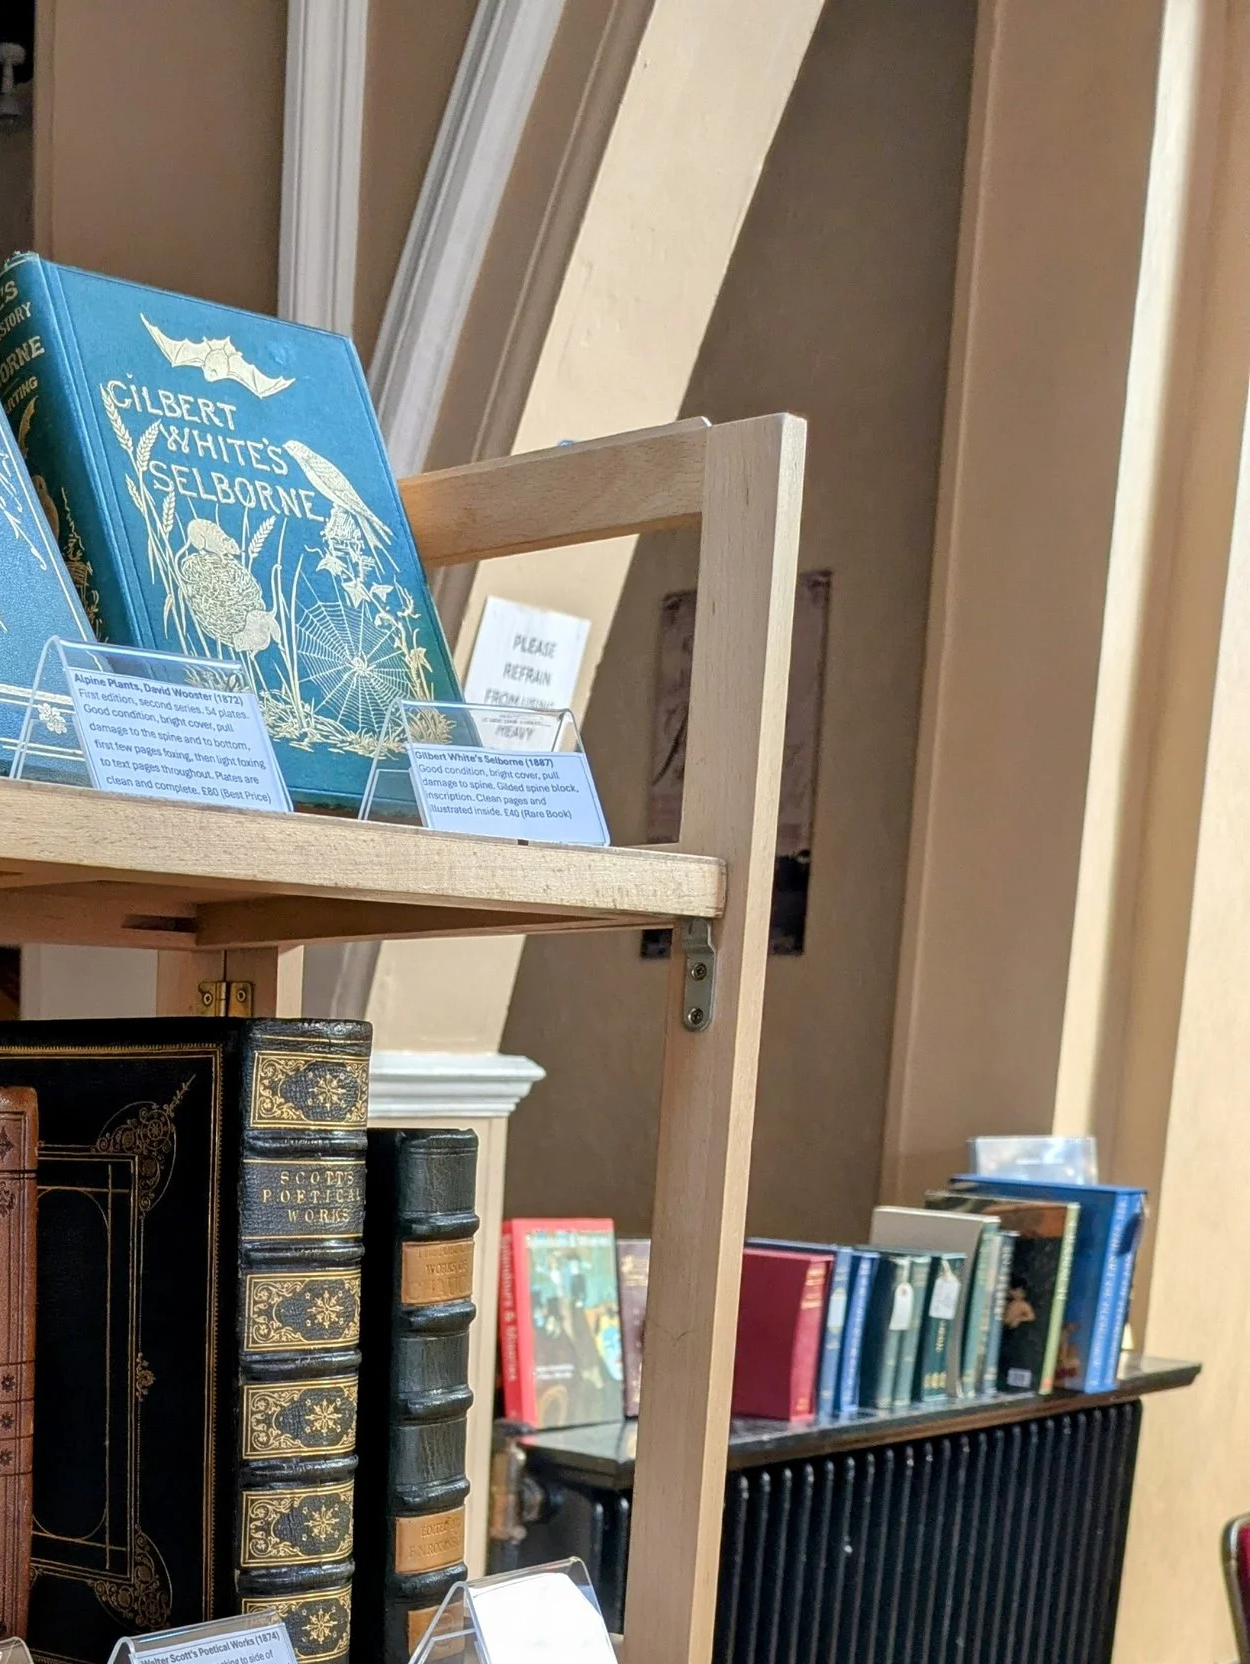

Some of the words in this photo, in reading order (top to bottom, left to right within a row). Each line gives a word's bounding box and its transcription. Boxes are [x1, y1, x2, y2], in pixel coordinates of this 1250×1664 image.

[107, 373, 236, 430] GILBERT
[159, 423, 288, 475] WHITE'S
[512, 634, 558, 659] PLEASE
[503, 662, 552, 686] REFRAIN
[74, 674, 106, 687] Alpine
[107, 679, 142, 693] Plants,
[144, 684, 171, 696] David
[173, 689, 213, 701] Wooster
[214, 693, 243, 707] (1872)
[415, 751, 447, 761] Gilbert
[448, 753, 483, 763] White's
[484, 755, 524, 766] Selborne
[525, 758, 554, 768] (1887)
[419, 764, 443, 774] Good
[444, 766, 488, 778] condition,
[489, 769, 513, 780] bright
[515, 772, 541, 780] cover,
[542, 772, 559, 781] pull
[289, 1208, 350, 1223] WORKS
[170, 1651, 199, 1664] Scott's
[199, 1644, 230, 1657] Poetical
[230, 1638, 255, 1651] Works
[255, 1631, 280, 1646] (1874)
[240, 1656, 249, 1664] to
[249, 1652, 265, 1663] side
[265, 1650, 273, 1659] of
